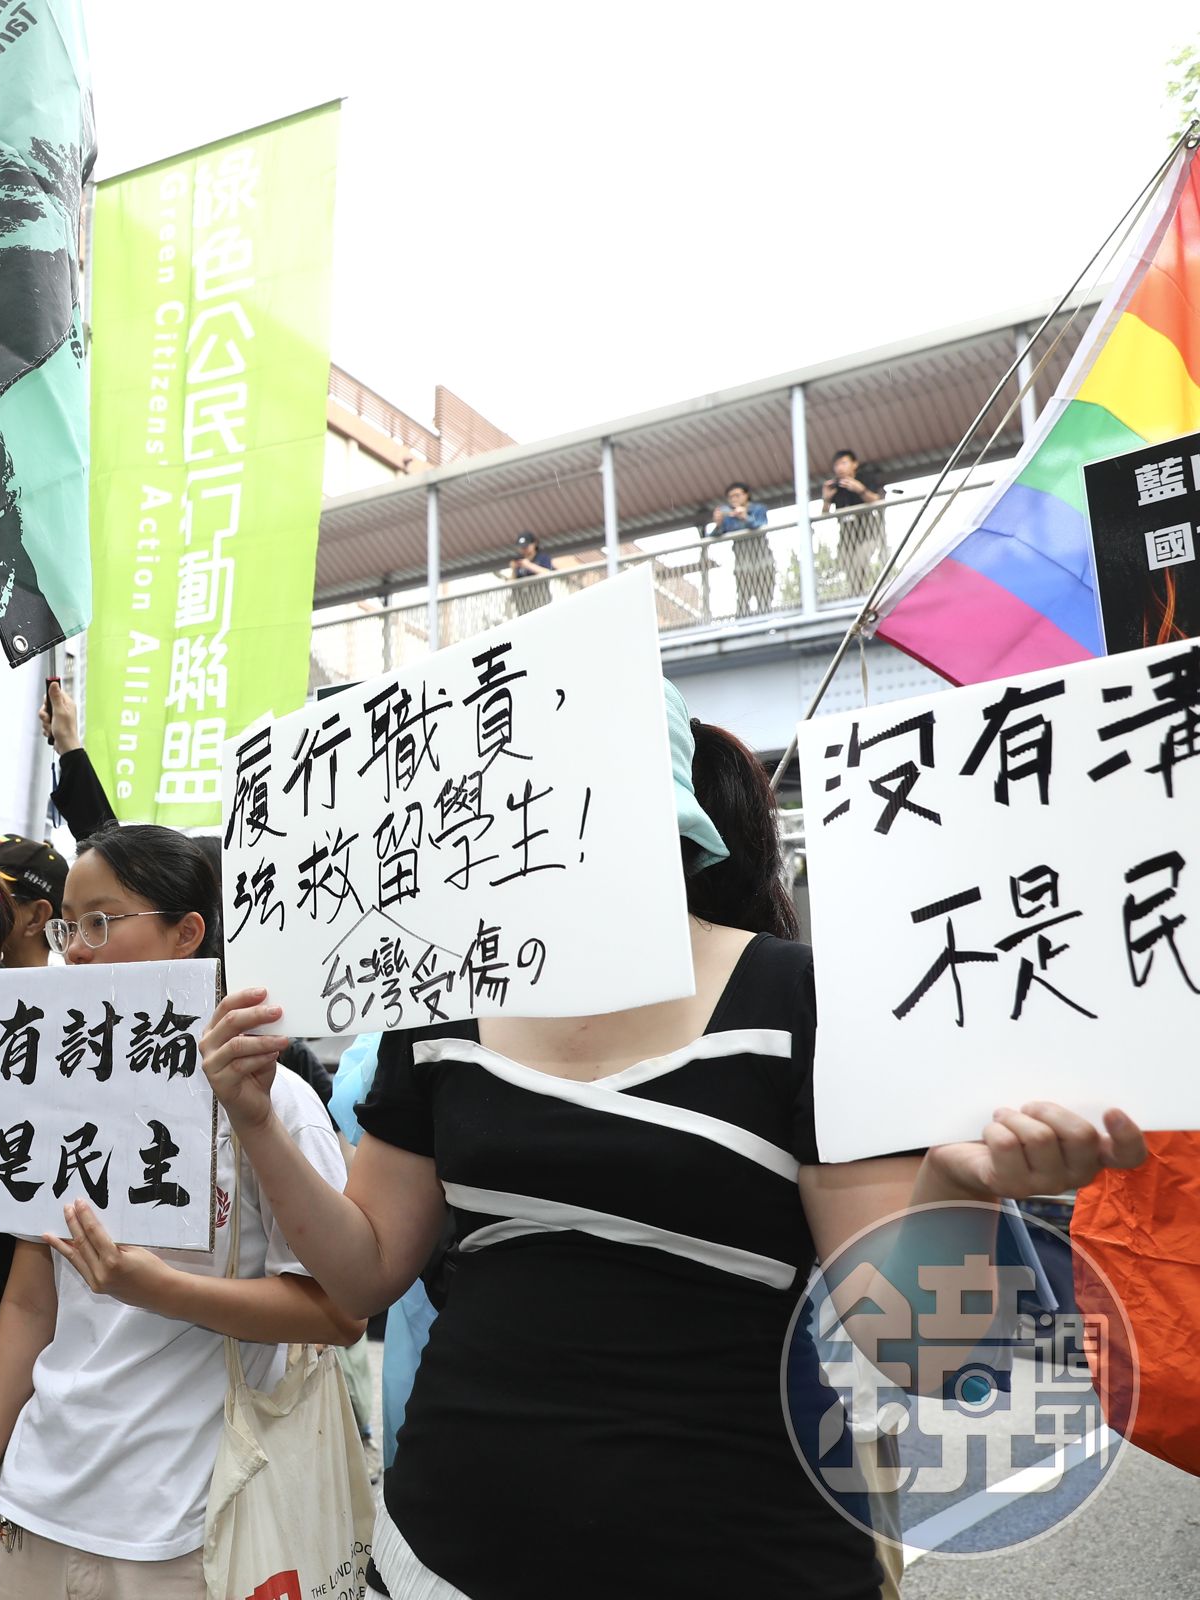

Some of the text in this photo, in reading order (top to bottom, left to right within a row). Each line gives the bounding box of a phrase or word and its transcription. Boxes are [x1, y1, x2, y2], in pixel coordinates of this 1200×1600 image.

[117, 172, 188, 802] Green Citizens' Action Alliance
[155, 147, 262, 805] 綠色公民行動聯盟
[1134, 454, 1200, 507] 藍
[1144, 521, 1200, 572] 國
[320, 918, 546, 1032] 台灣受傷の
[891, 850, 1200, 1028] 不是民
